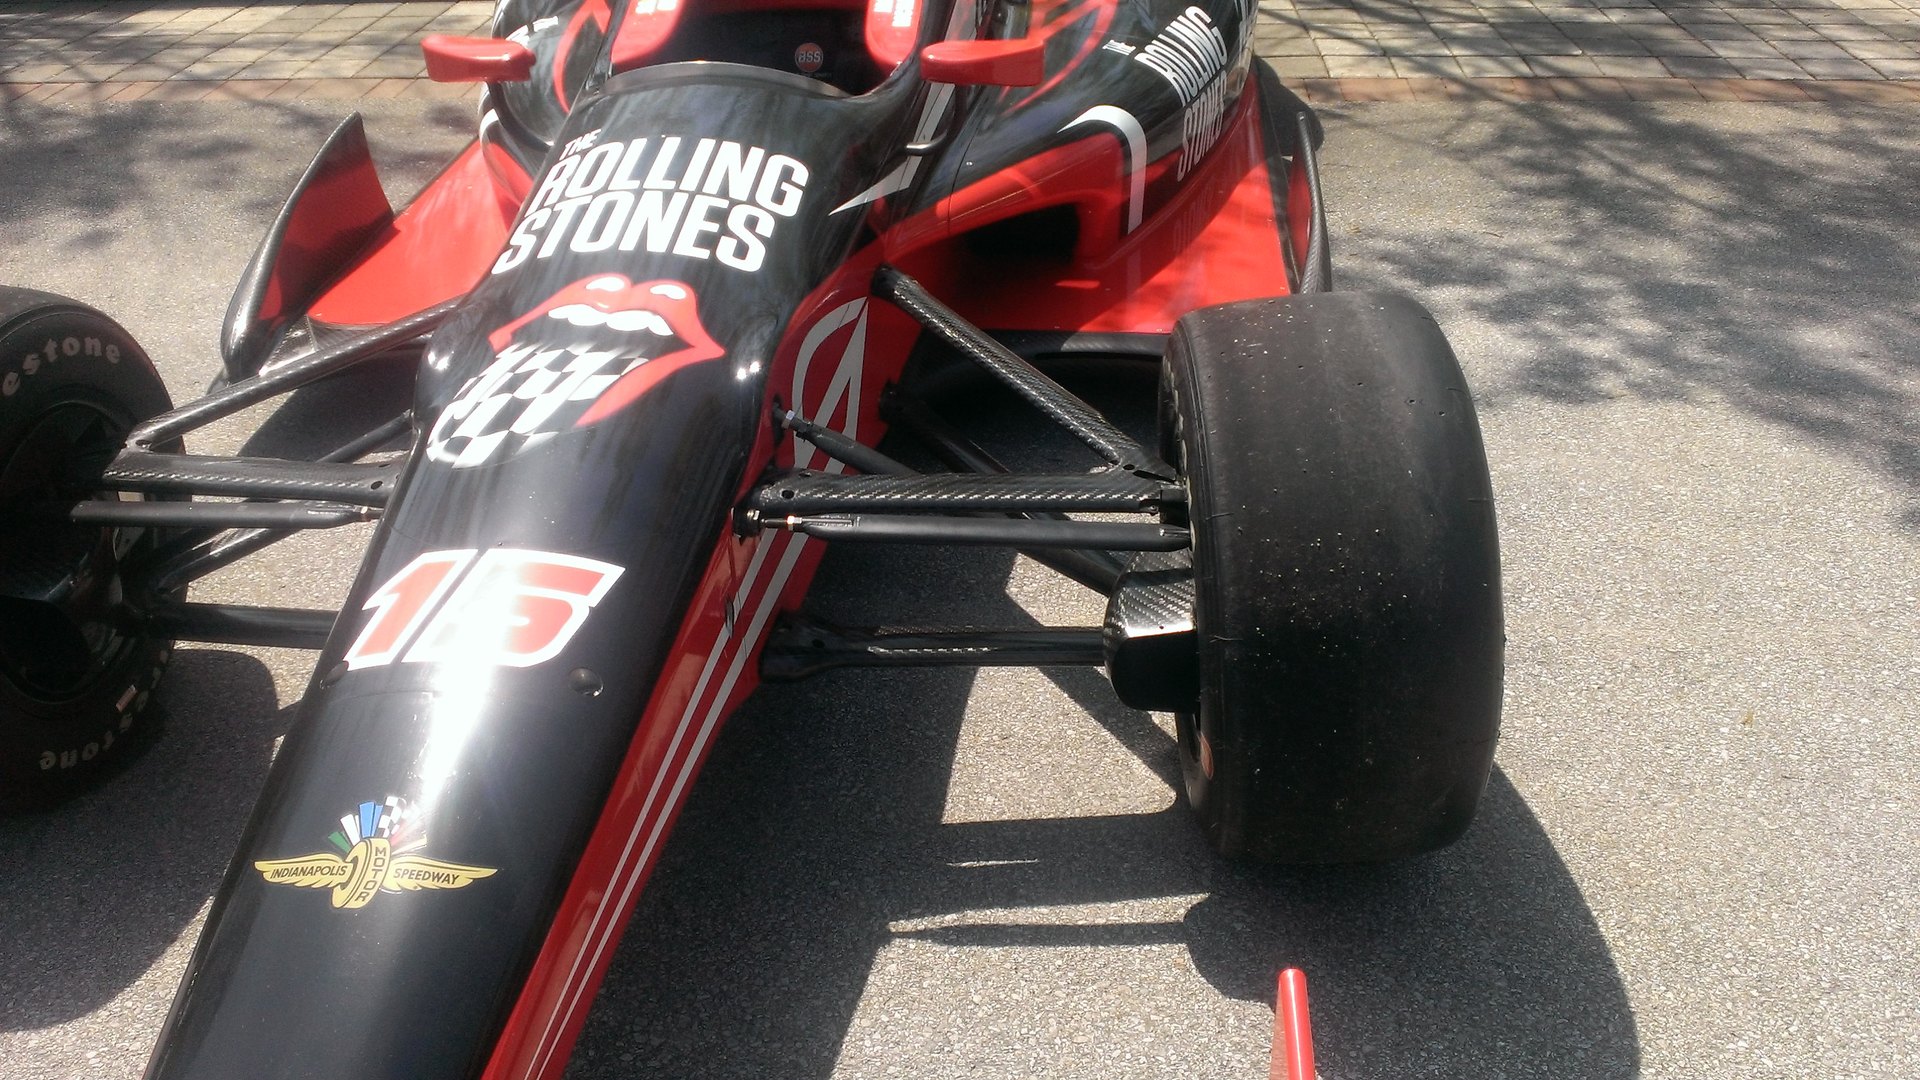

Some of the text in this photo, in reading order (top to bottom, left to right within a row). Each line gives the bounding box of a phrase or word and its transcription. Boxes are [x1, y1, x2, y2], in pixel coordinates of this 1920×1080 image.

[1134, 6, 1228, 107] ROLLING
[559, 129, 602, 161] THE
[1177, 70, 1227, 182] STONES
[524, 137, 811, 217] ROLLING
[491, 190, 776, 274] STONES
[270, 846, 460, 902] INDIANAPOLIS MOTOR SPEEDWAY
